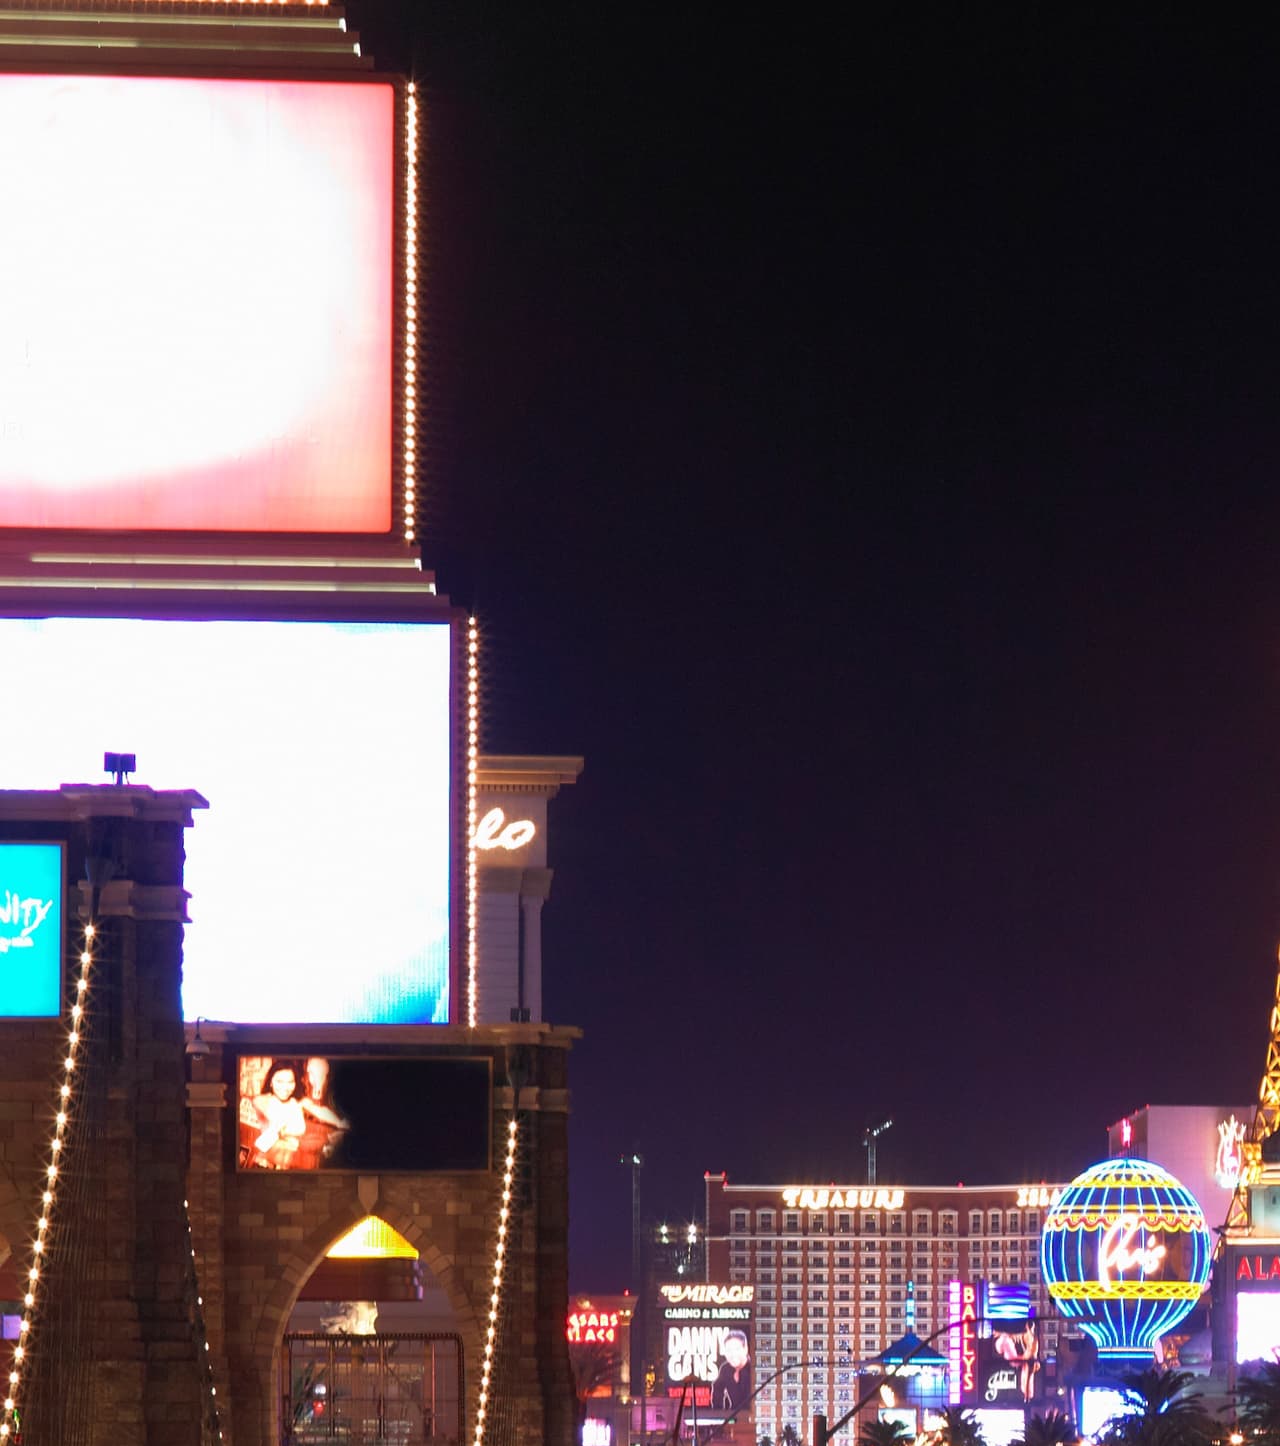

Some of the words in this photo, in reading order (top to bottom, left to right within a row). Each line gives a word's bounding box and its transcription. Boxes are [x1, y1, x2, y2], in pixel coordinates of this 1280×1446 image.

[782, 1188, 905, 1210] TREASURE
[668, 1285, 754, 1304] MIRAGE
[665, 1308, 701, 1318] CASINO
[711, 1308, 750, 1318] RESORT
[668, 1327, 728, 1356] DANNY
[962, 1286, 976, 1390] BALLYS
